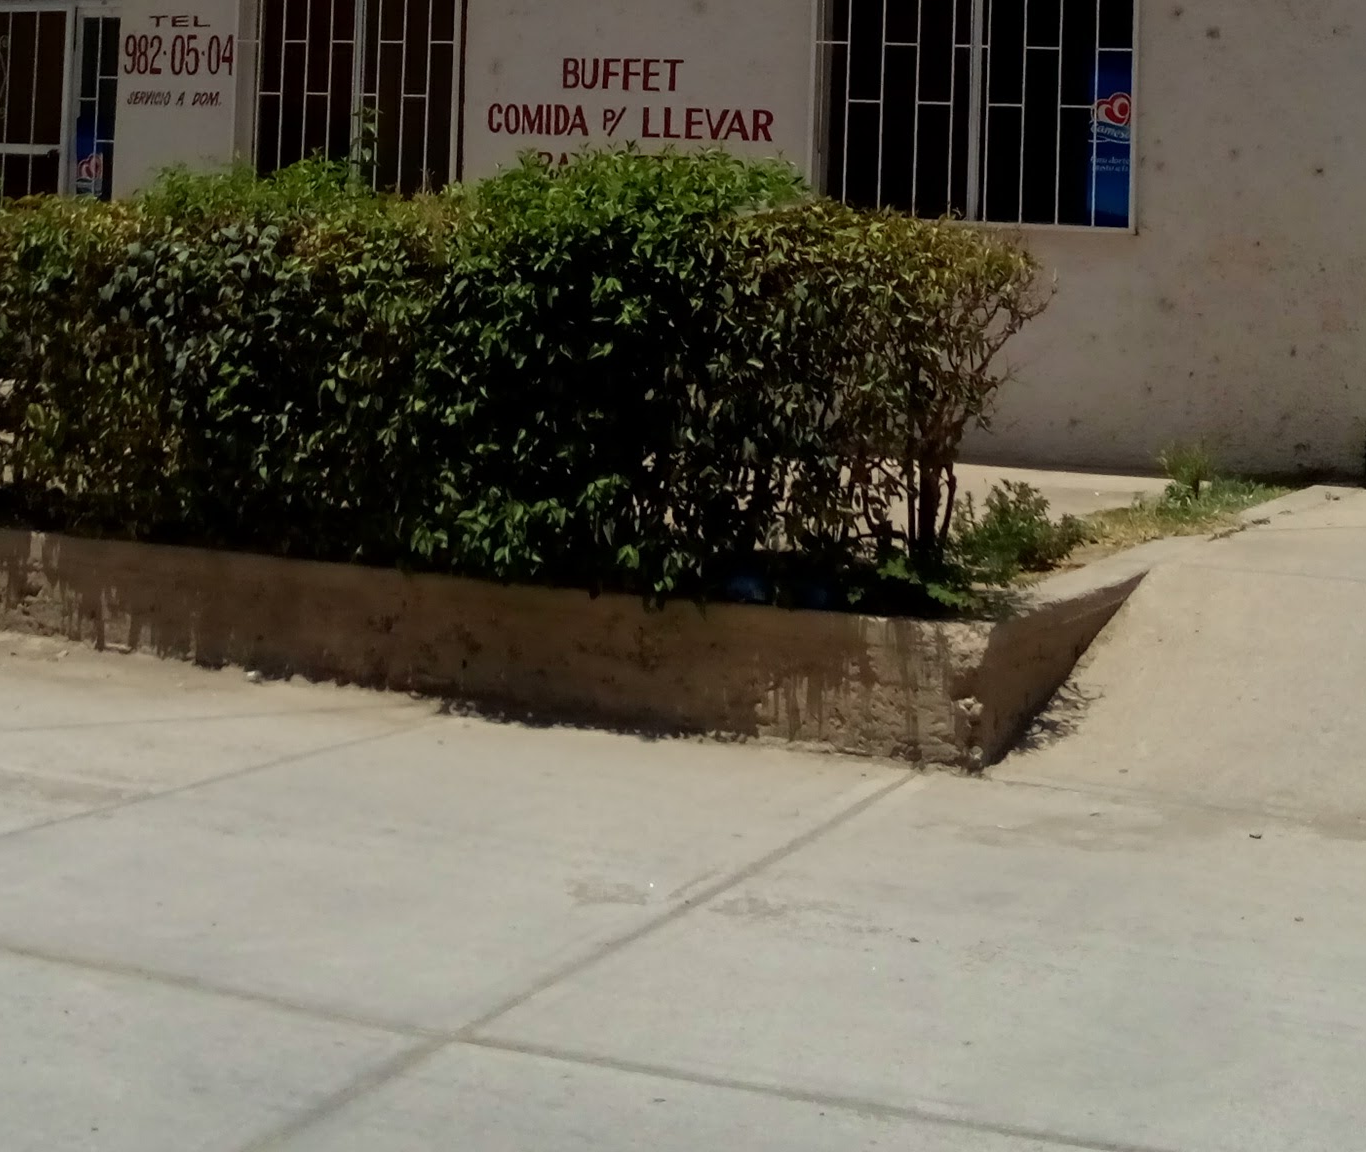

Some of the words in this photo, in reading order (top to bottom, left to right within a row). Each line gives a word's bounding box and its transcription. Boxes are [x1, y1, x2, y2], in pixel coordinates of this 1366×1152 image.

[562, 57, 685, 92] BUFFET
[126, 89, 172, 106] SERVICIO
[175, 91, 186, 107] A
[487, 103, 589, 136] COMIDA
[641, 106, 774, 142] LLEVAR
